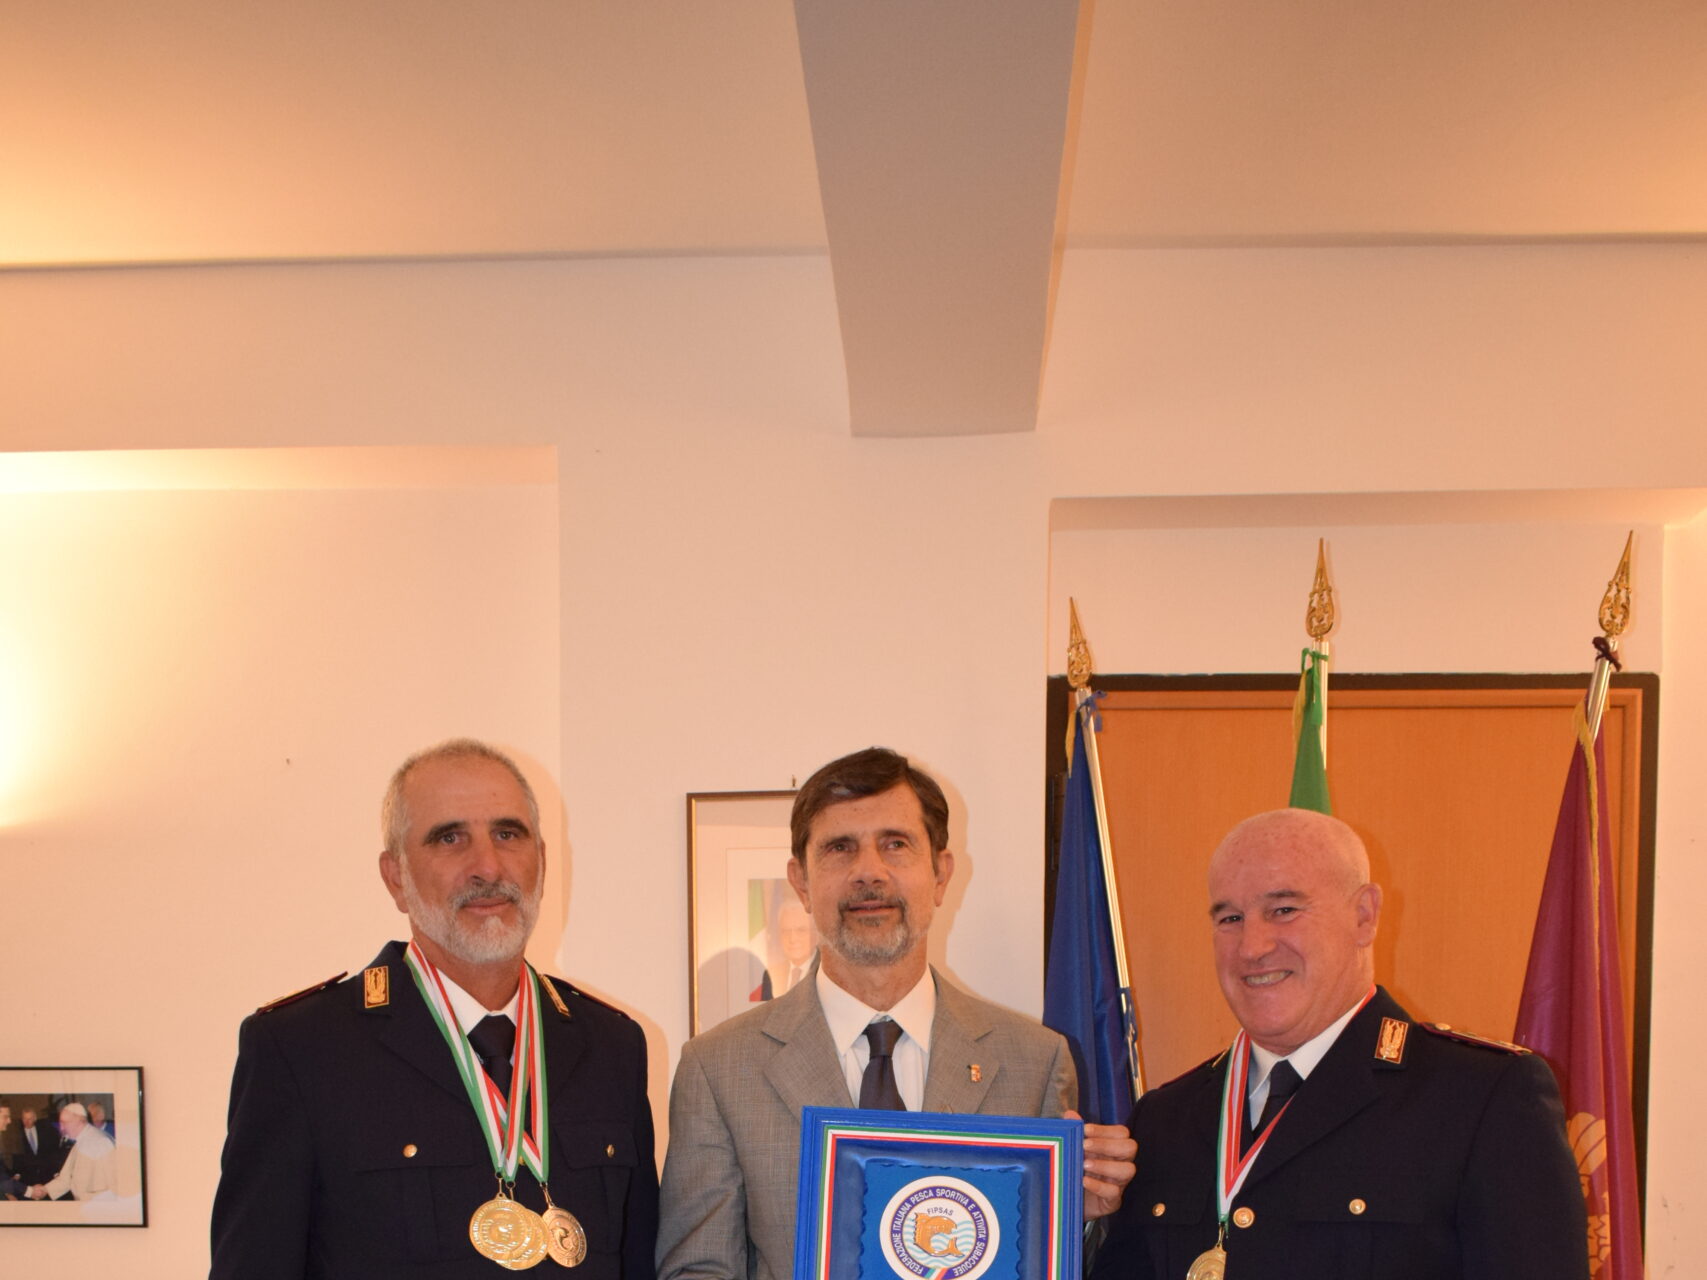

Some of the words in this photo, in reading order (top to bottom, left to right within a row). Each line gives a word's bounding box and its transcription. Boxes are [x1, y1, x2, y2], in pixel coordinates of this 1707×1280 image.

[910, 1189, 934, 1205] PESCA
[935, 1188, 970, 1206] SPORTIVA
[927, 1206, 954, 1216] FIPSAS
[967, 1203, 976, 1211] E
[893, 1202, 912, 1231] ITALIANA
[893, 1233, 924, 1274] FEDERAZIONE
[952, 1241, 985, 1277] SUBACQUEE
